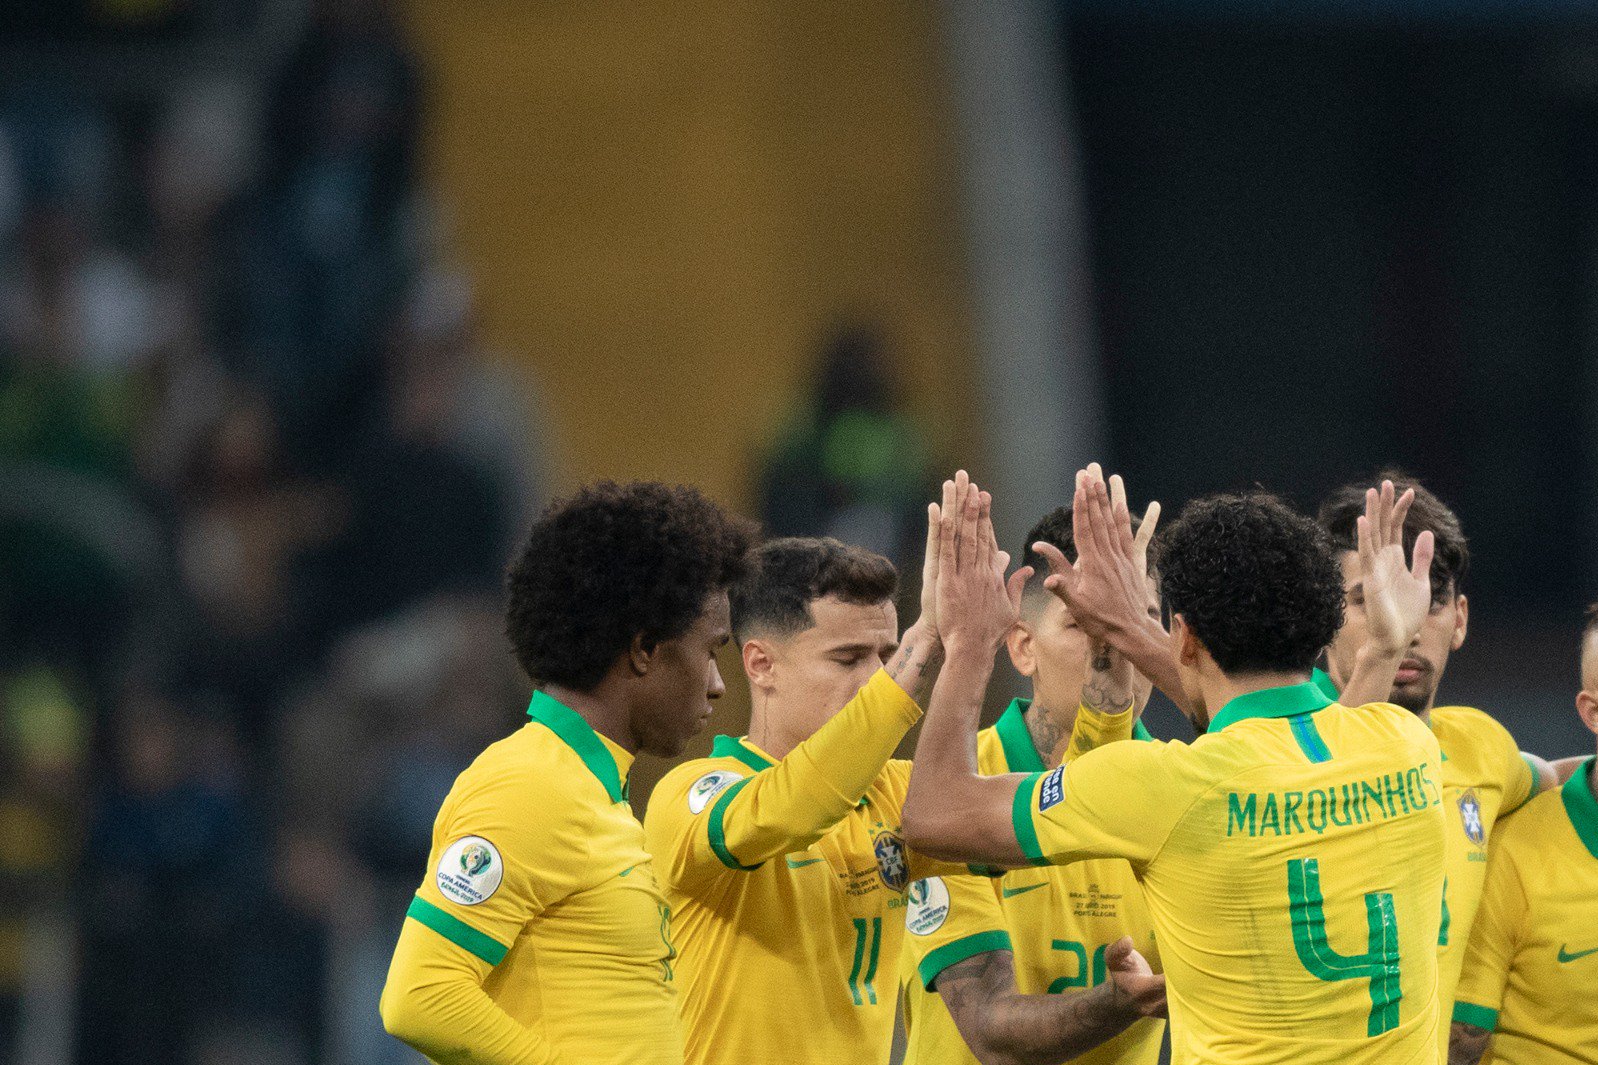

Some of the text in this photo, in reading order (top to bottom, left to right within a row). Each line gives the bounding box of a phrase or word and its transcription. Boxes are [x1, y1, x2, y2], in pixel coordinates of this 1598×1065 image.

[1227, 763, 1440, 837] MARQUINHOS
[848, 917, 882, 1006] 11
[1286, 858, 1403, 1038] 4
